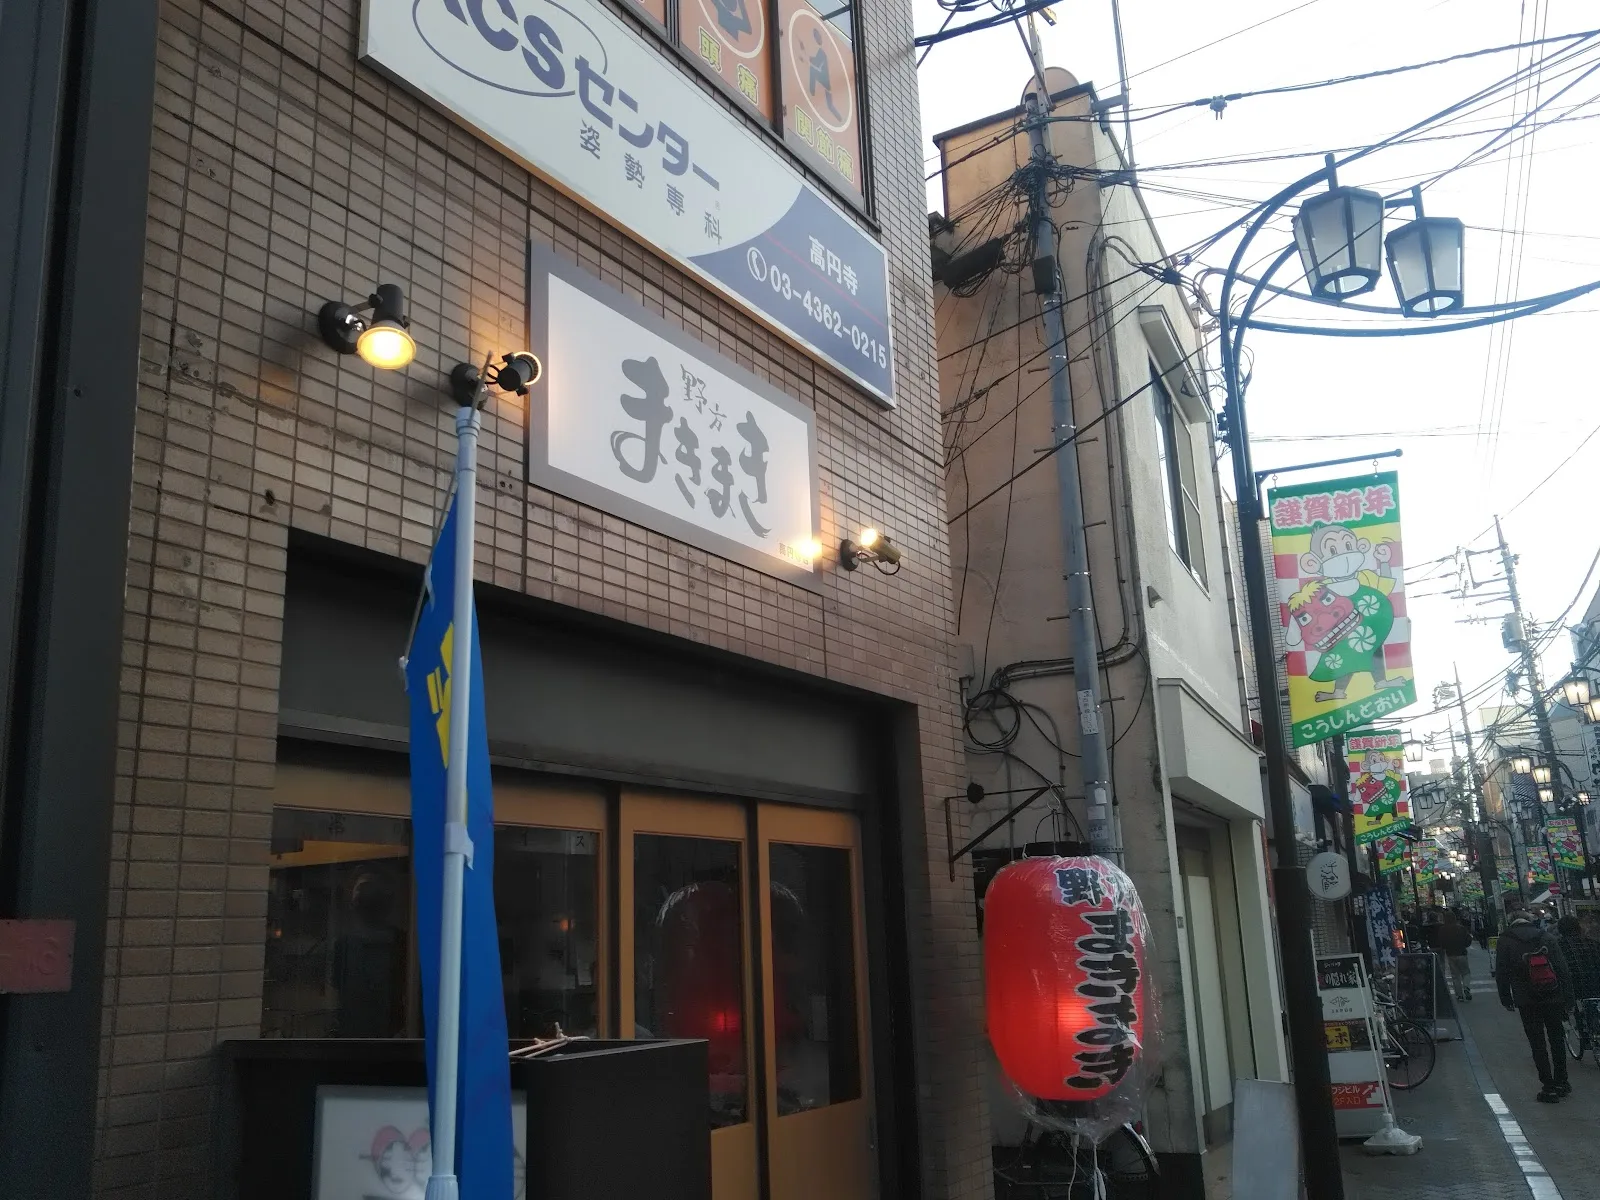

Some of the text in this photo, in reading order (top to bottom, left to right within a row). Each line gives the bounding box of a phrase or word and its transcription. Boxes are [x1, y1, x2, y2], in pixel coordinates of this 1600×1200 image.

[443, 0, 720, 192] CS センター
[699, 26, 758, 105] 頭痛
[579, 119, 723, 246] 姿勢専科
[795, 105, 854, 183] 関節痛
[808, 235, 858, 296] 高円寺
[770, 264, 887, 369] 03-4362-0215
[680, 363, 727, 432] 野方
[610, 356, 772, 539] まきまき
[1272, 485, 1395, 528] 謹賀新年
[1301, 689, 1407, 739] こうしんとおり
[1360, 821, 1407, 842] こうしんとおり
